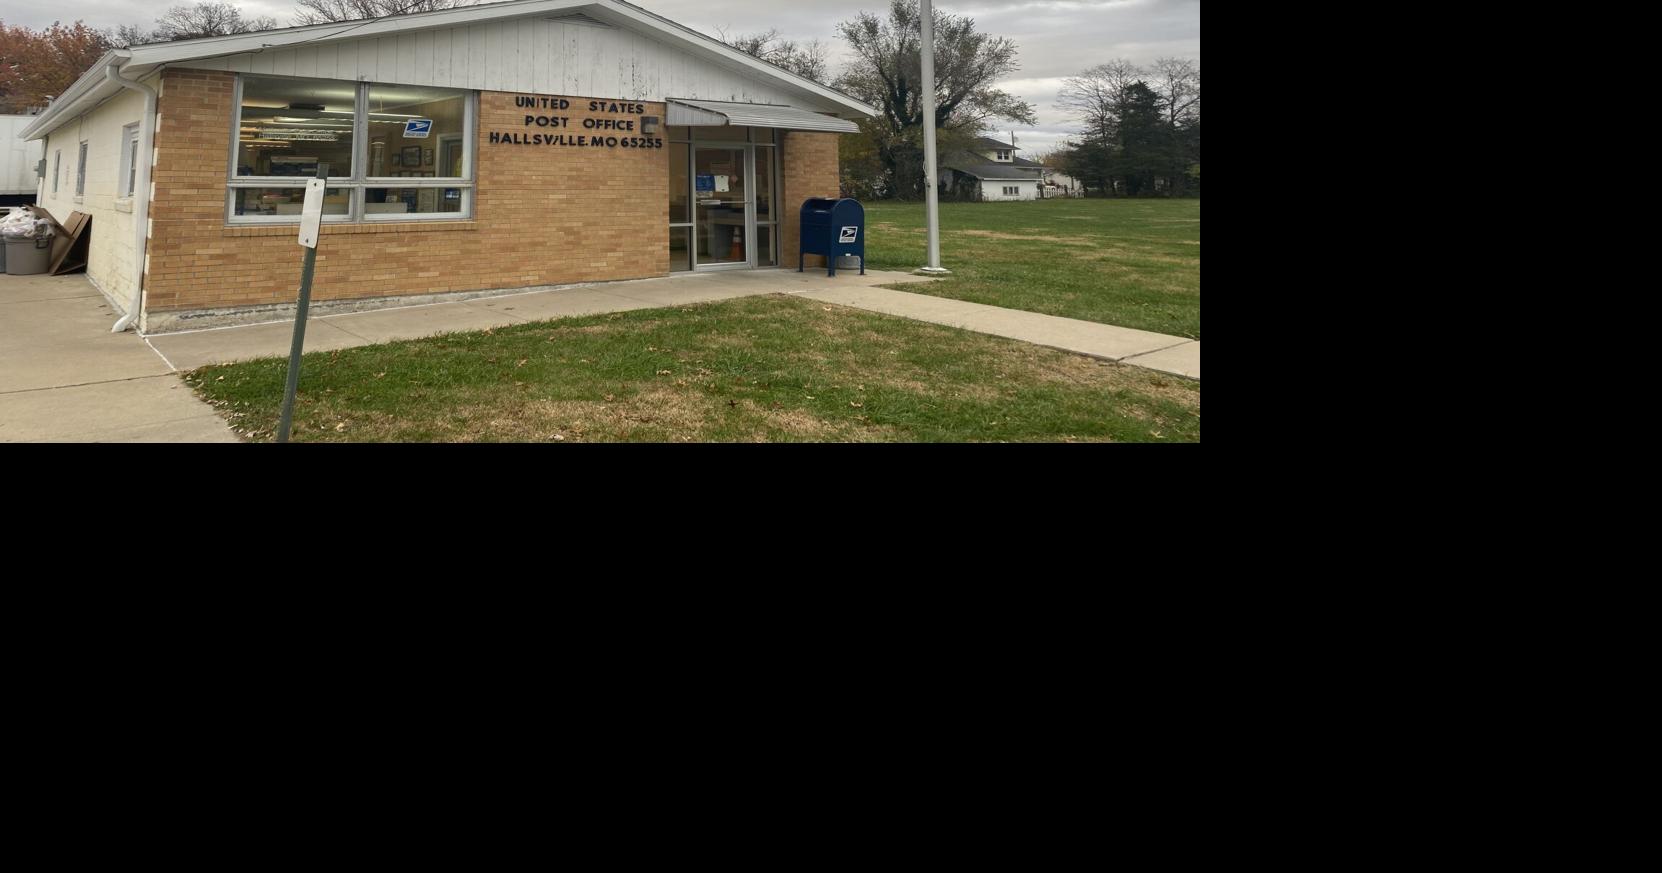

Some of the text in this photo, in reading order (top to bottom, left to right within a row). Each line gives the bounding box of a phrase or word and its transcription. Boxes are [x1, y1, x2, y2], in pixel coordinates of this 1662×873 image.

[515, 96, 644, 114] UNITED STATES
[525, 115, 634, 131] POST OFFICE
[620, 137, 663, 149] 65255
